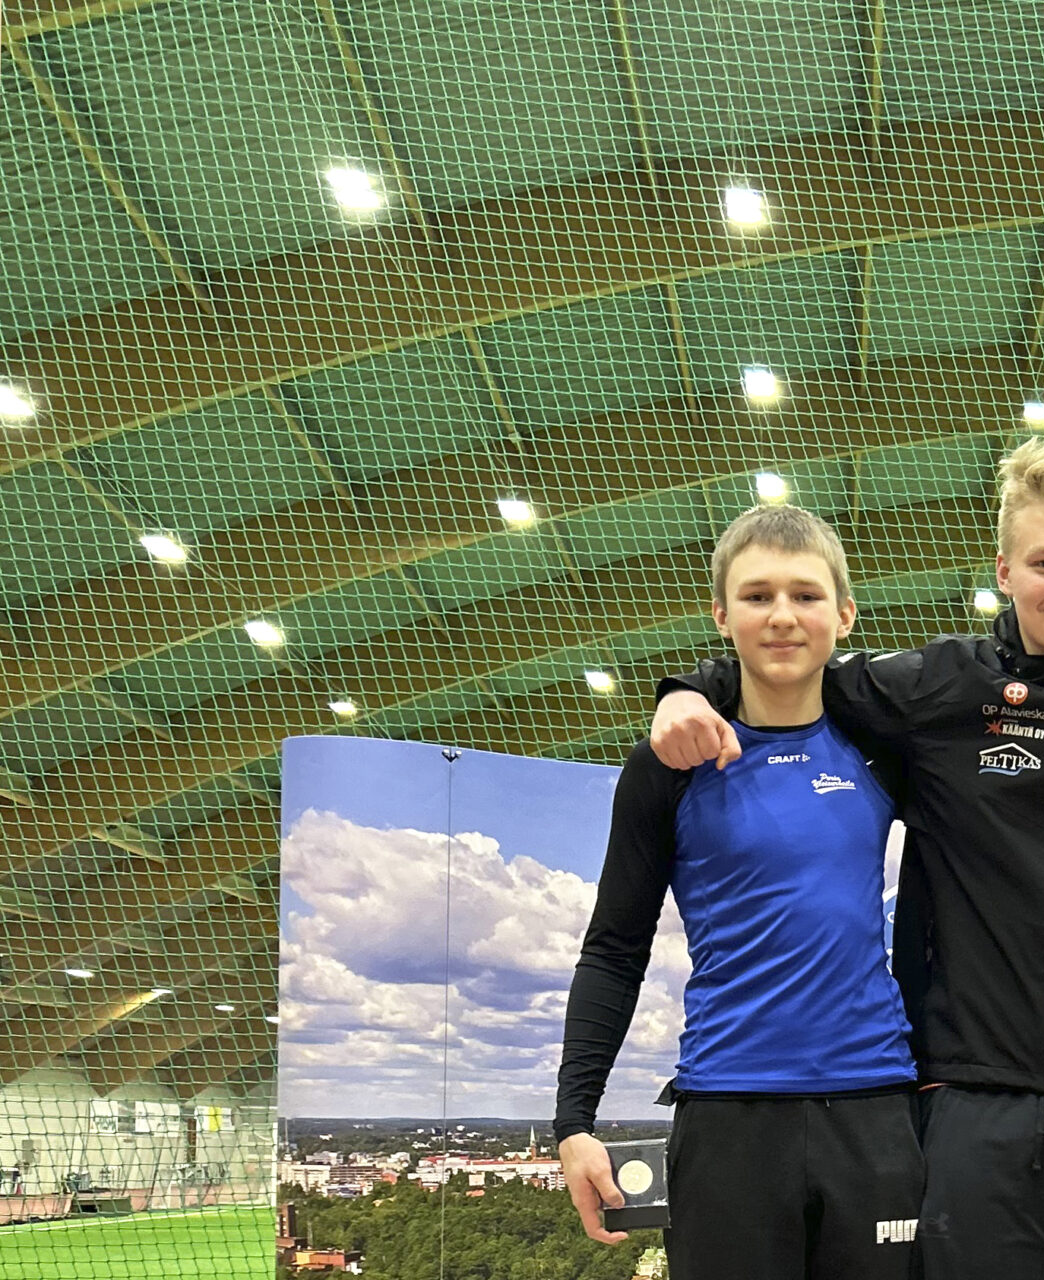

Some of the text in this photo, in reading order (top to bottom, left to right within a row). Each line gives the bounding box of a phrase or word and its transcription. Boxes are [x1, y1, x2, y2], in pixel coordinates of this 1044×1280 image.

[982, 704, 998, 715] OP
[767, 754, 801, 764] CRAFT
[980, 753, 1041, 770] PELTIKAS
[876, 1218, 919, 1244] PUM
